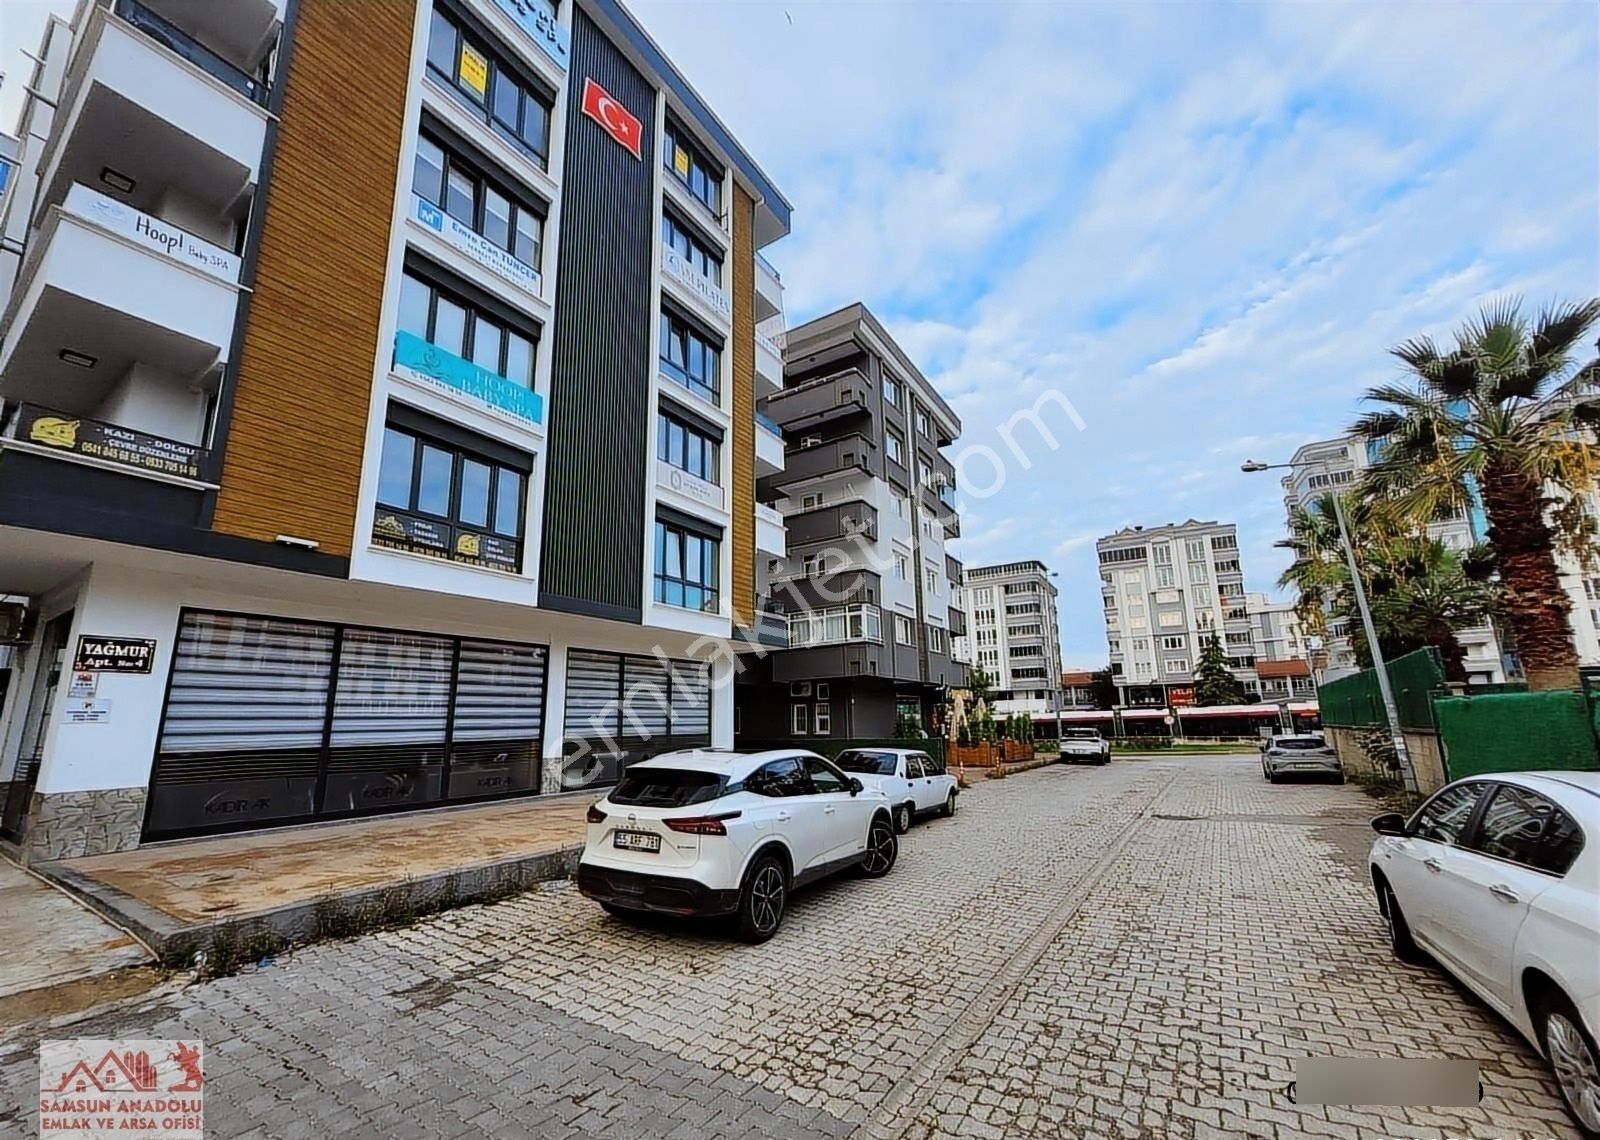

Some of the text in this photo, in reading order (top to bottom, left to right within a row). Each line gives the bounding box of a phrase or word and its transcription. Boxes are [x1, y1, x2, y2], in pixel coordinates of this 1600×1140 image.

[135, 215, 229, 271] Hoop! Baby SPA
[480, 241, 499, 258] Can
[103, 427, 195, 456] KAZI DOLGU
[83, 641, 149, 657] YAĞMUR
[84, 657, 113, 668] Apt.
